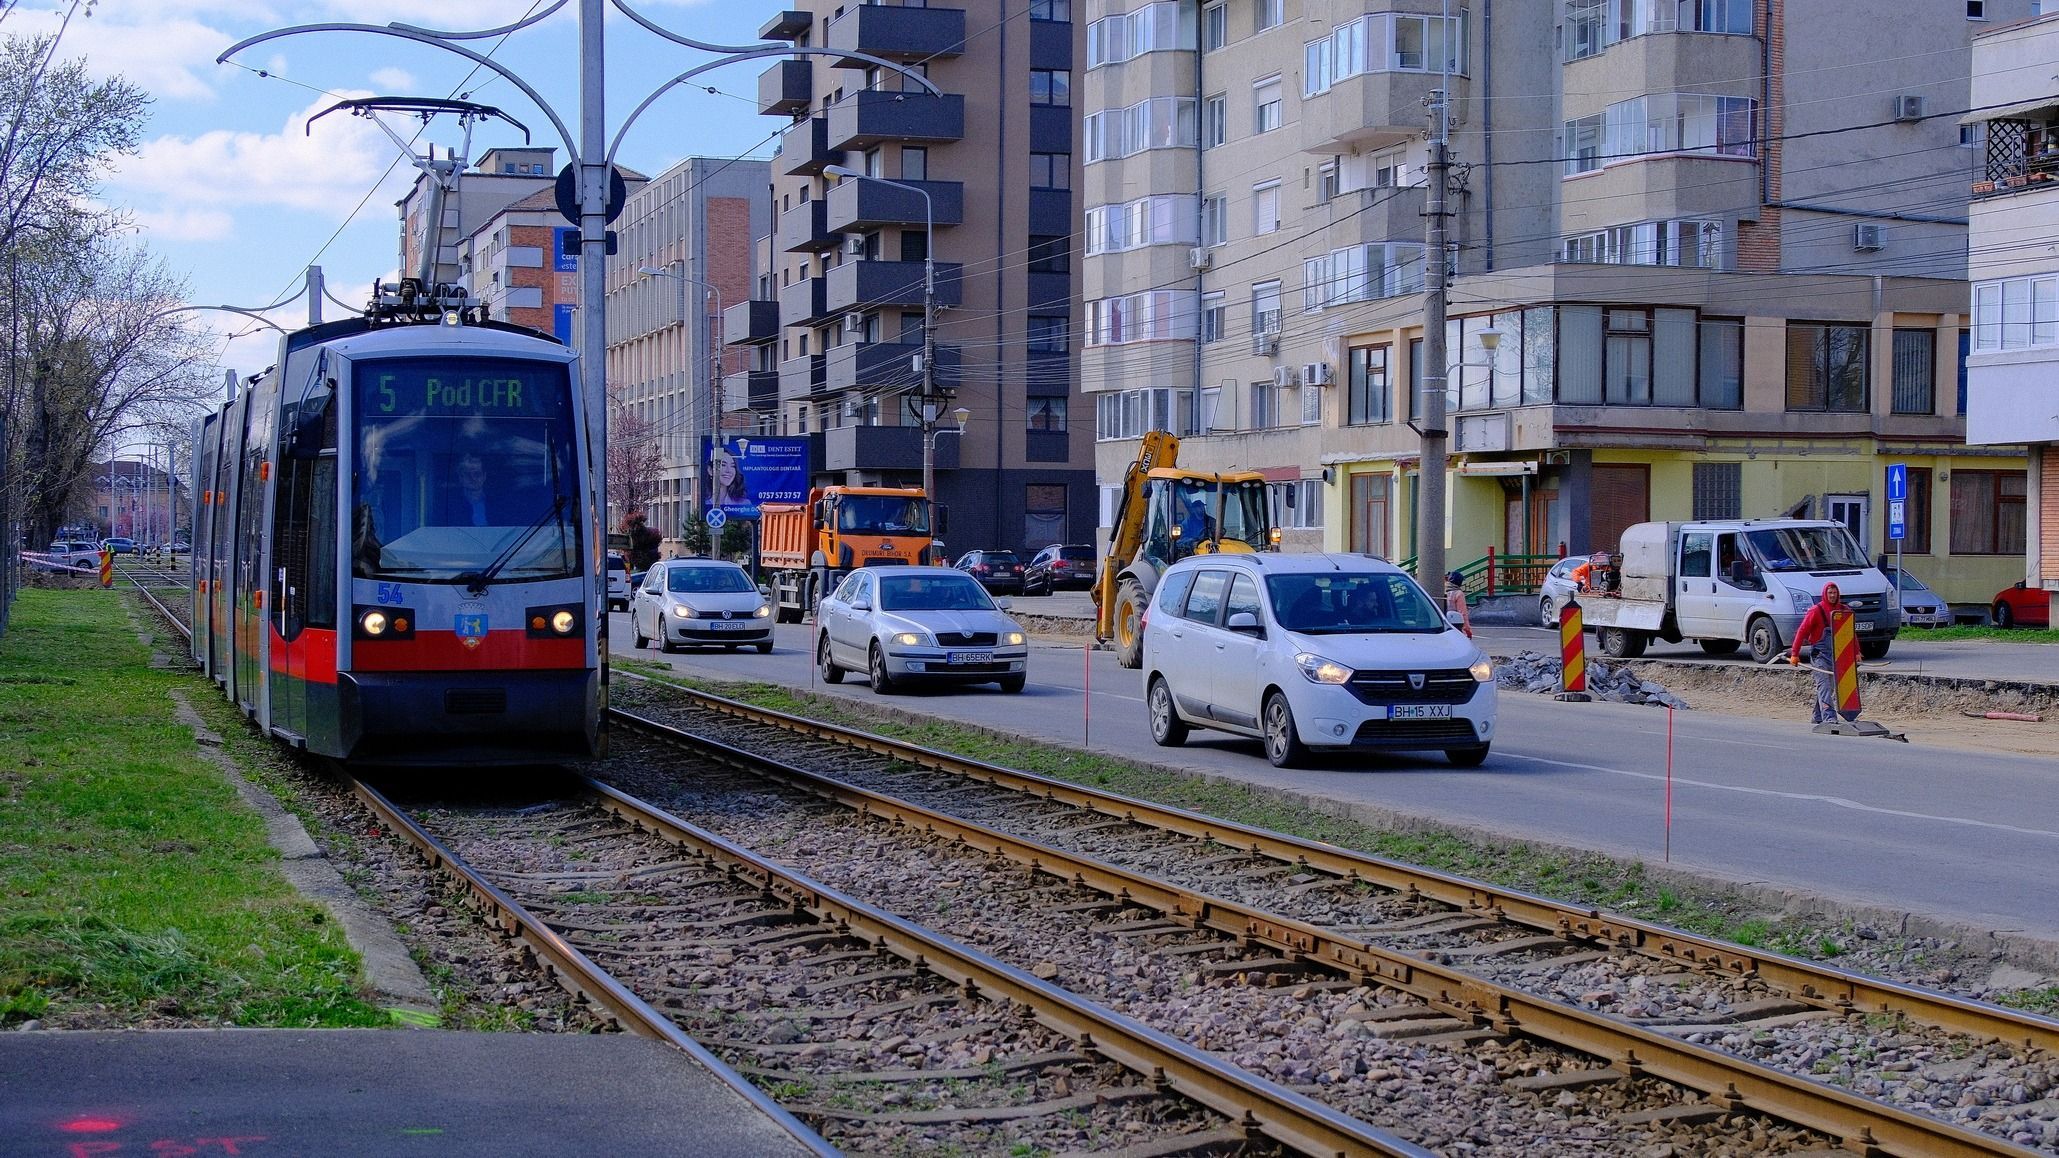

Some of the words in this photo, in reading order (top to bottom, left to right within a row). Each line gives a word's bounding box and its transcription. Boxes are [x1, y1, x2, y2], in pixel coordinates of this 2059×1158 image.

[379, 375, 396, 411] 5
[427, 378, 471, 407] Pod
[478, 379, 523, 407] CFR
[378, 582, 404, 604] 54
[952, 653, 964, 661] BH
[1394, 706, 1410, 718] BH
[1414, 706, 1425, 717] 15
[1429, 705, 1450, 717] XXJ
